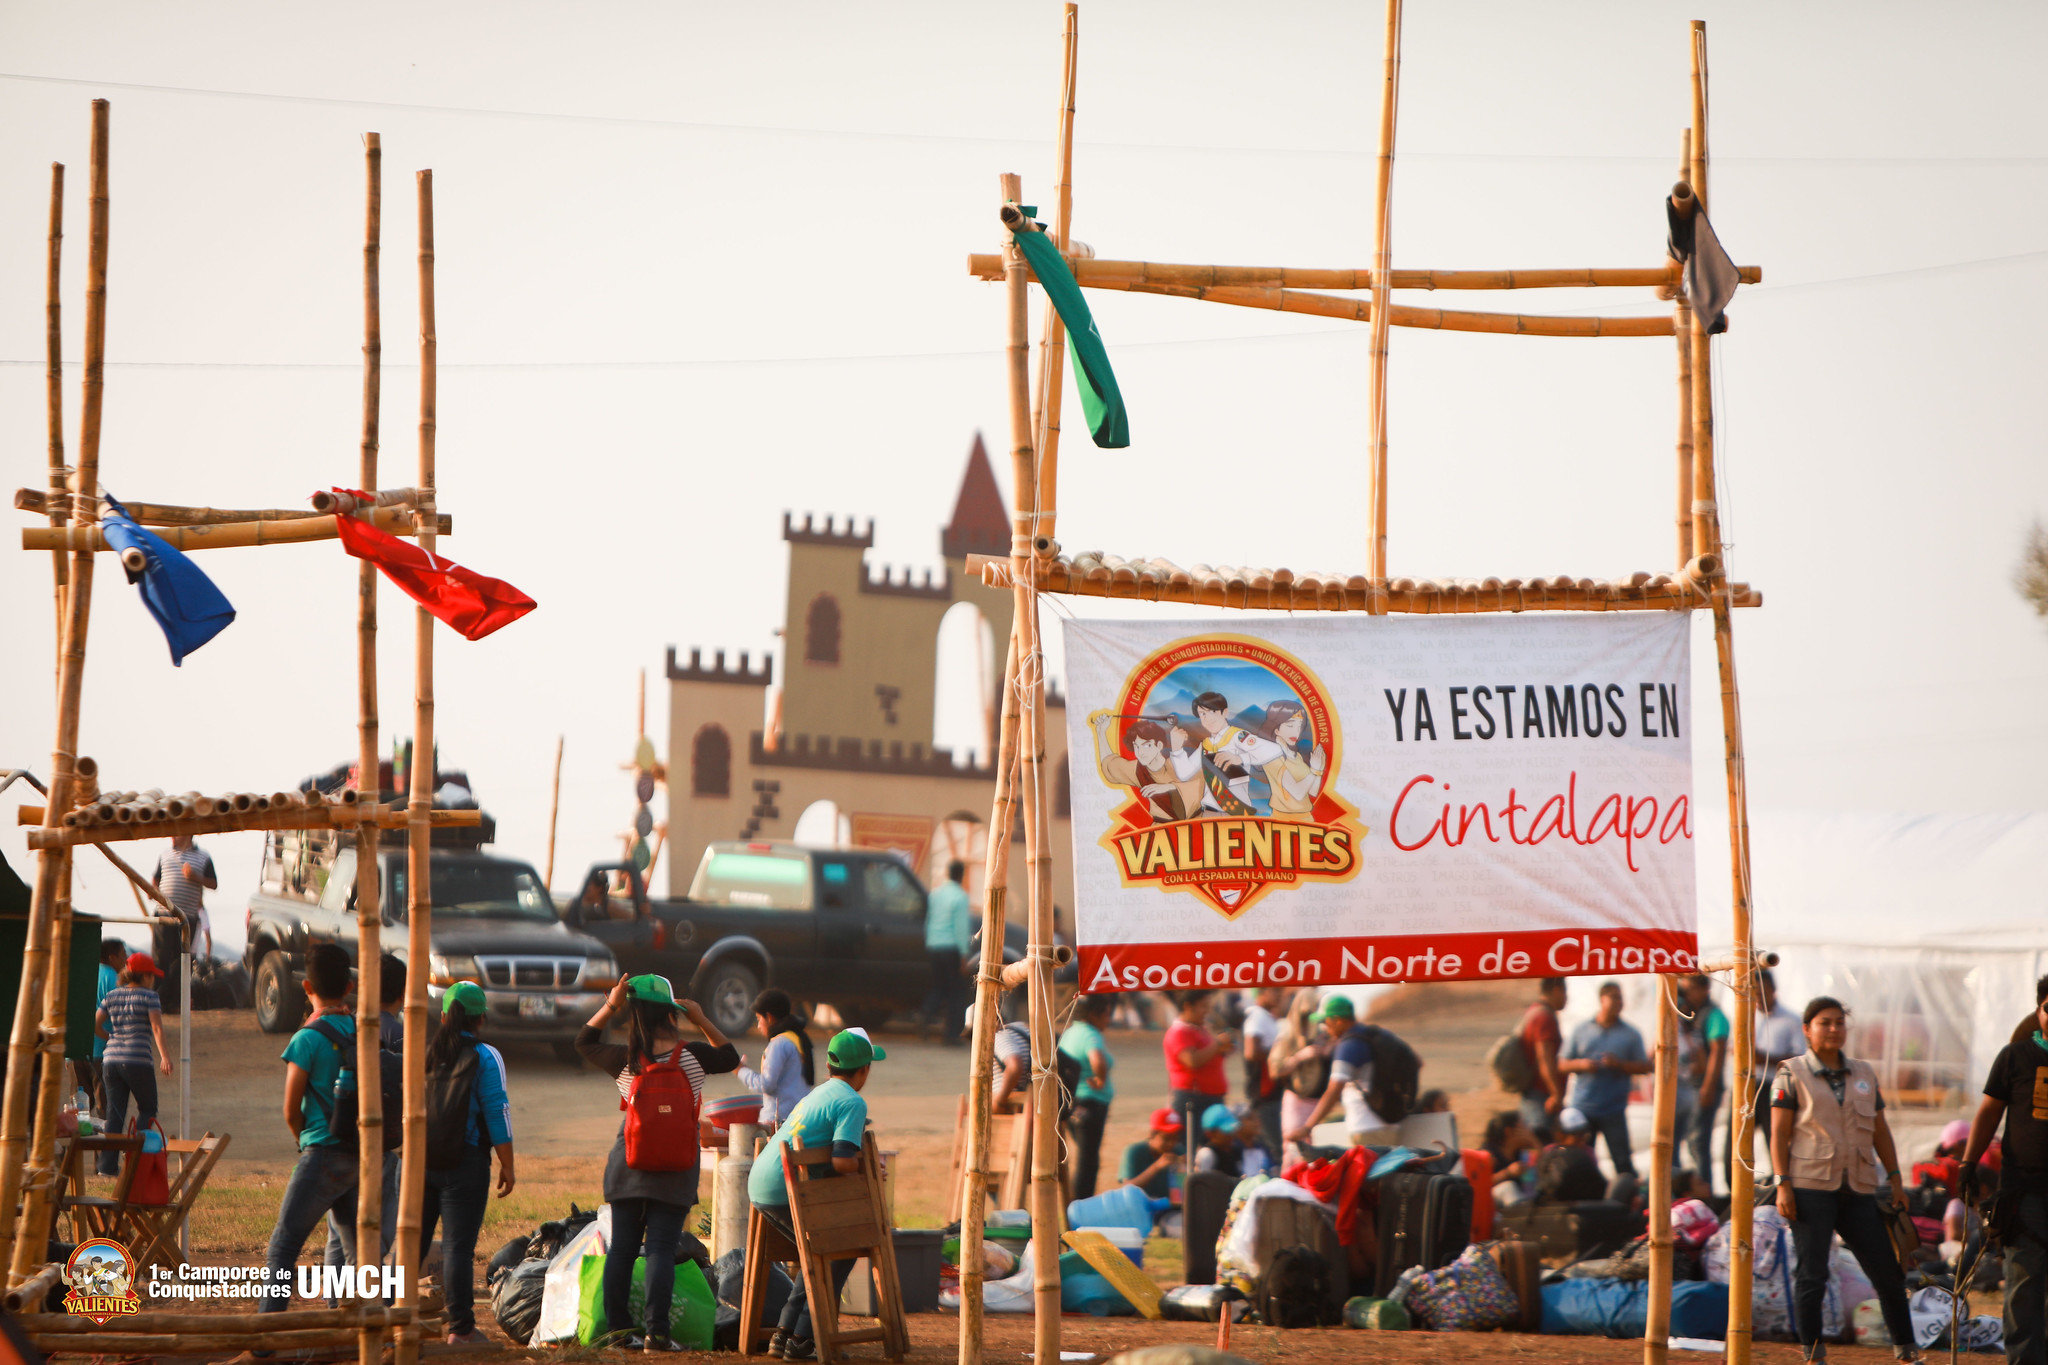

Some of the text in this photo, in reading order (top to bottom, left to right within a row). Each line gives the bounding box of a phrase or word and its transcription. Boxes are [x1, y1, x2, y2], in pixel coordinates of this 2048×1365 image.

[1158, 656, 1171, 669] DE
[1169, 643, 1243, 662] CONQUISTADORES
[1251, 648, 1278, 665] UNIÓN
[1308, 695, 1320, 707] DE
[1383, 687, 1437, 741] YA
[1449, 683, 1627, 740] ESTAMOS
[1639, 682, 1680, 737] EN
[1313, 707, 1329, 743] CHIAPAS
[1389, 770, 1692, 872] Cintalapa
[1118, 821, 1352, 875] VALIENTES
[1164, 870, 1294, 884] CON LA ESPADA EN LA MANO
[1087, 935, 1698, 991] Asociación Norte de Chiapa
